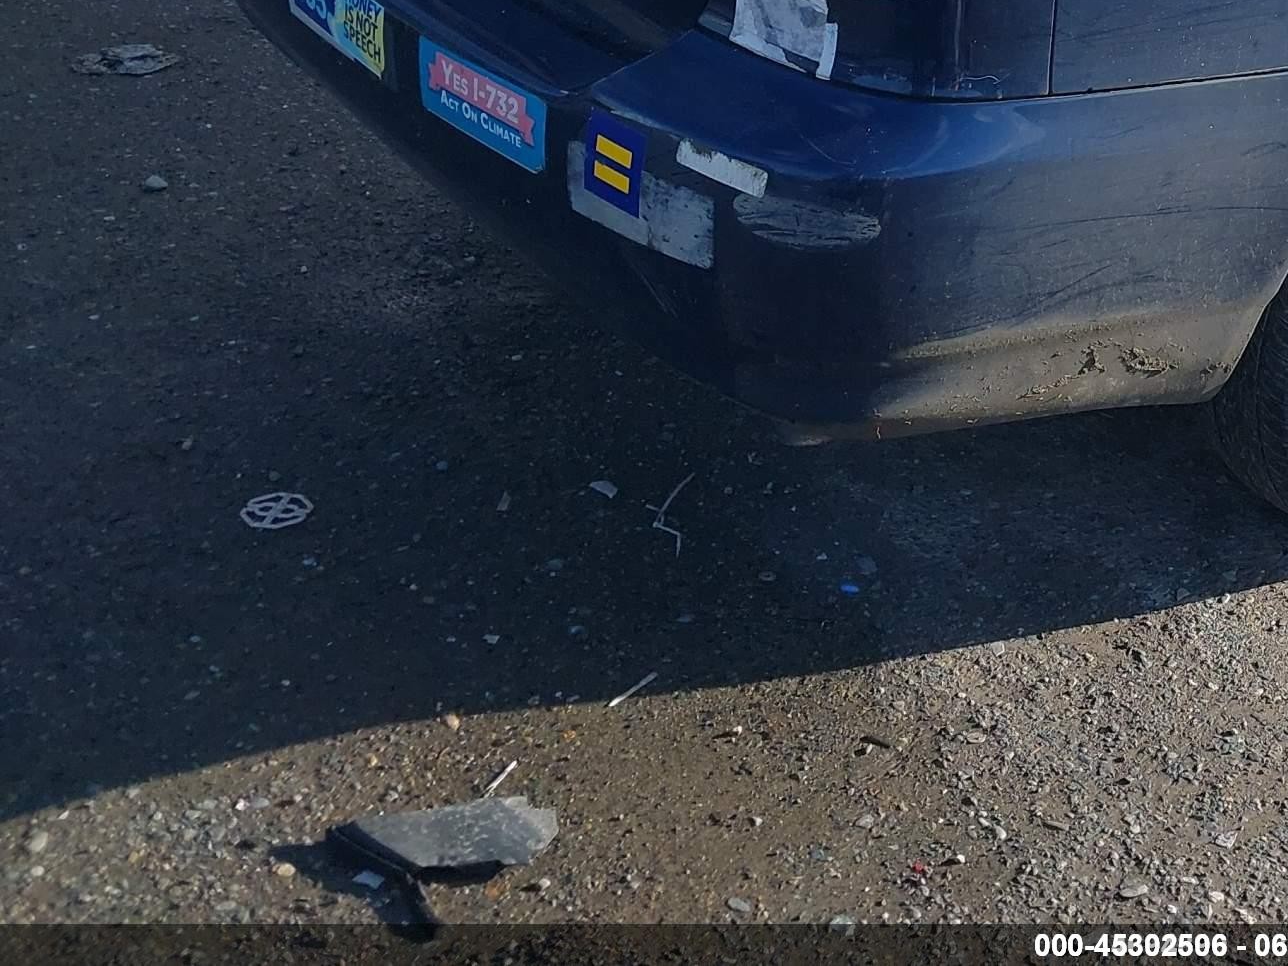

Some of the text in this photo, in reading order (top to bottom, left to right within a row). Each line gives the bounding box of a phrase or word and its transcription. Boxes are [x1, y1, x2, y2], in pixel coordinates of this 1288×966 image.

[343, 21, 382, 64] SPEECH
[344, 3, 379, 41] IS NOT
[473, 77, 520, 124] I-732
